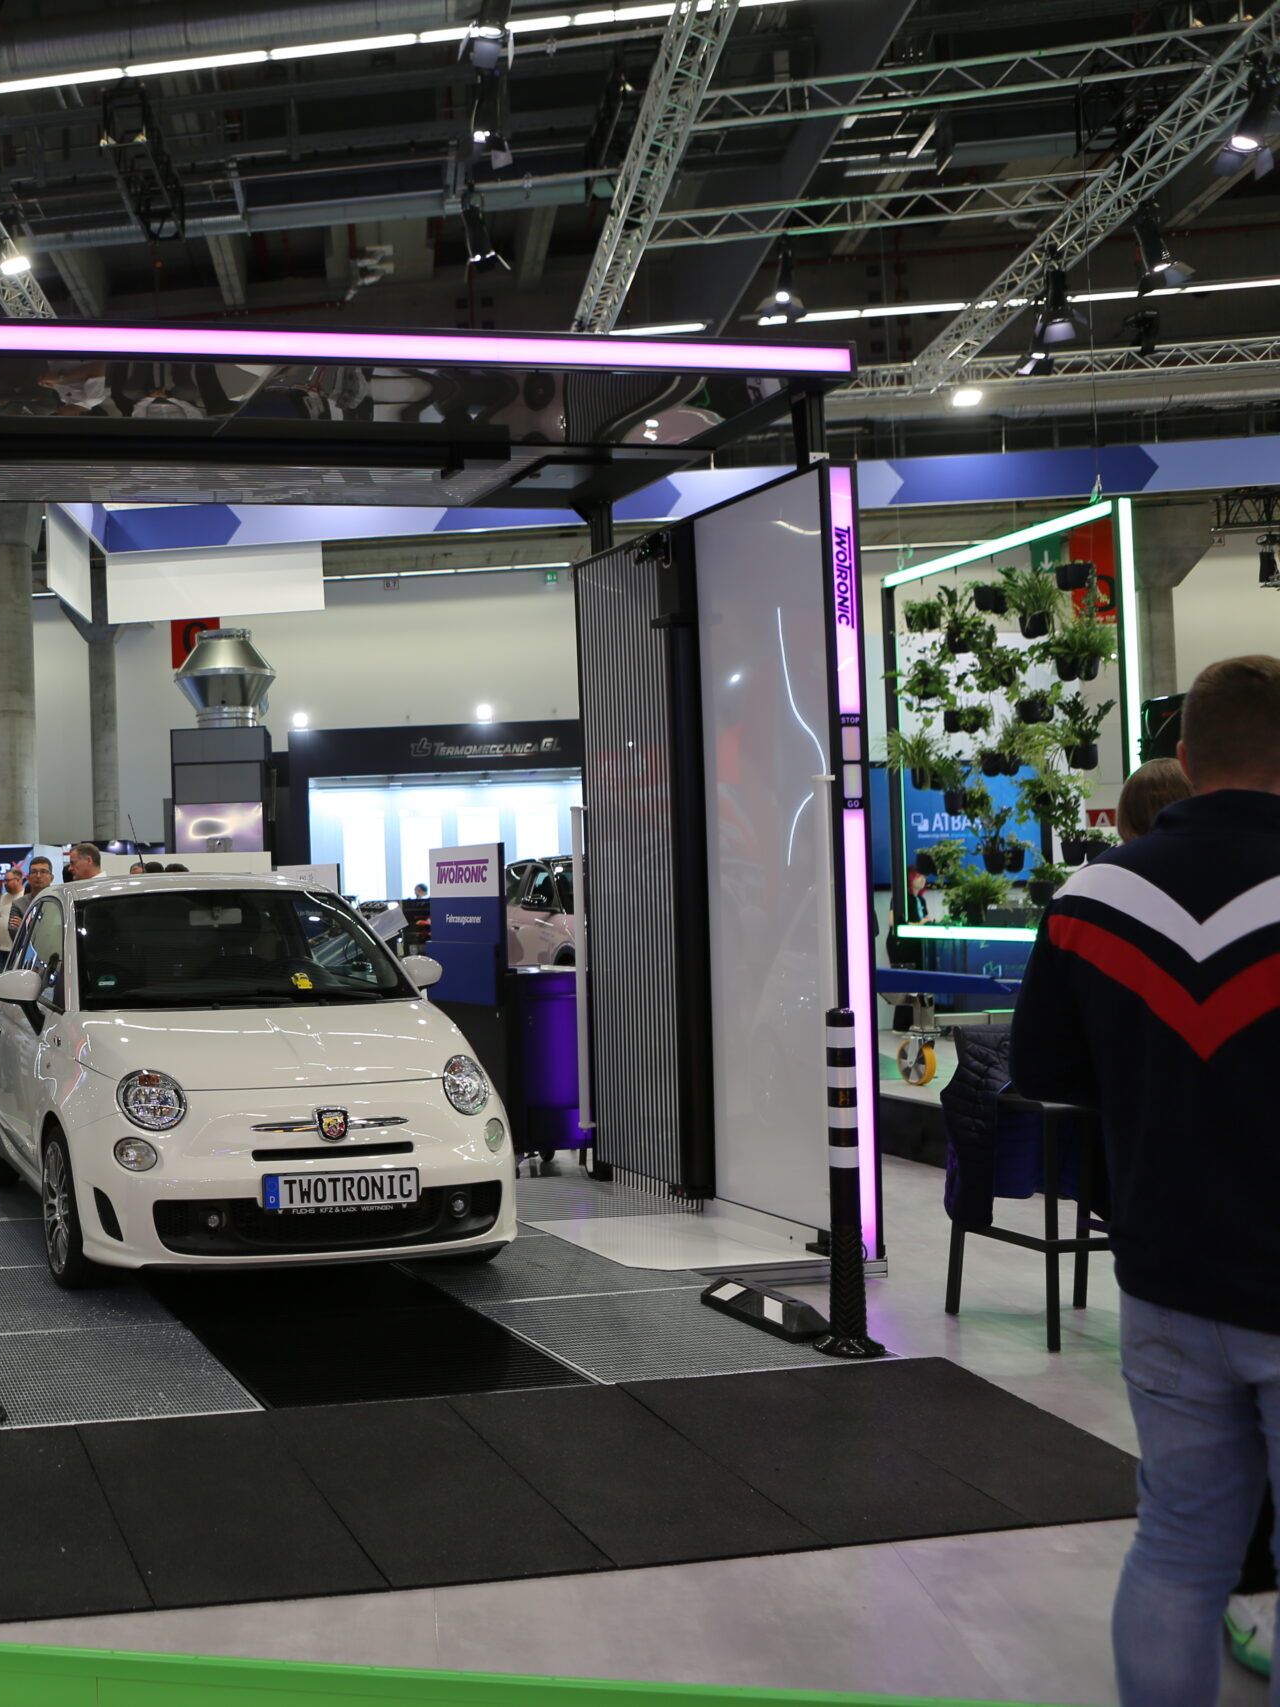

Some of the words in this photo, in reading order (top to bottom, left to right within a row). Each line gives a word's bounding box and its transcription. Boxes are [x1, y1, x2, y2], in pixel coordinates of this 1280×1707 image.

[834, 525, 855, 630] TWOTRONIC
[841, 716, 860, 724] STOP
[433, 742, 539, 756] TERMOMECCANICA
[847, 800, 860, 808] GO
[435, 858, 489, 884] TWOTRONIC
[445, 914, 482, 926] Fahrzeugscanner
[269, 1195, 276, 1204] D
[283, 1174, 412, 1205] TWOTRONIC
